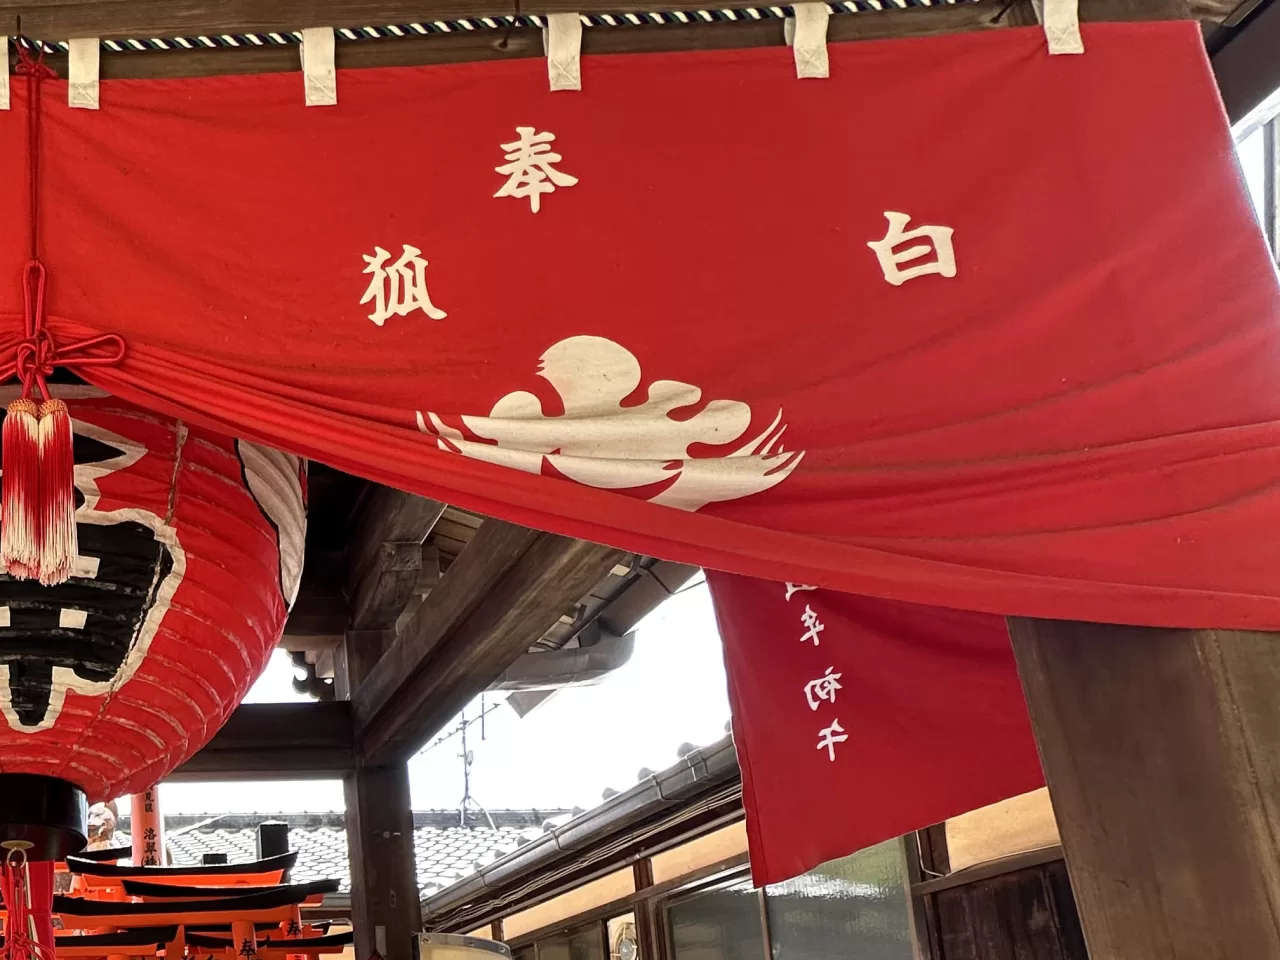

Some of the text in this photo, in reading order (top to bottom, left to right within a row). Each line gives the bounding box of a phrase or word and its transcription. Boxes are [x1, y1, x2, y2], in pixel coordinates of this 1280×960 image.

[493, 126, 578, 213] 奉
[359, 244, 447, 326] 狐
[866, 211, 957, 287] 白
